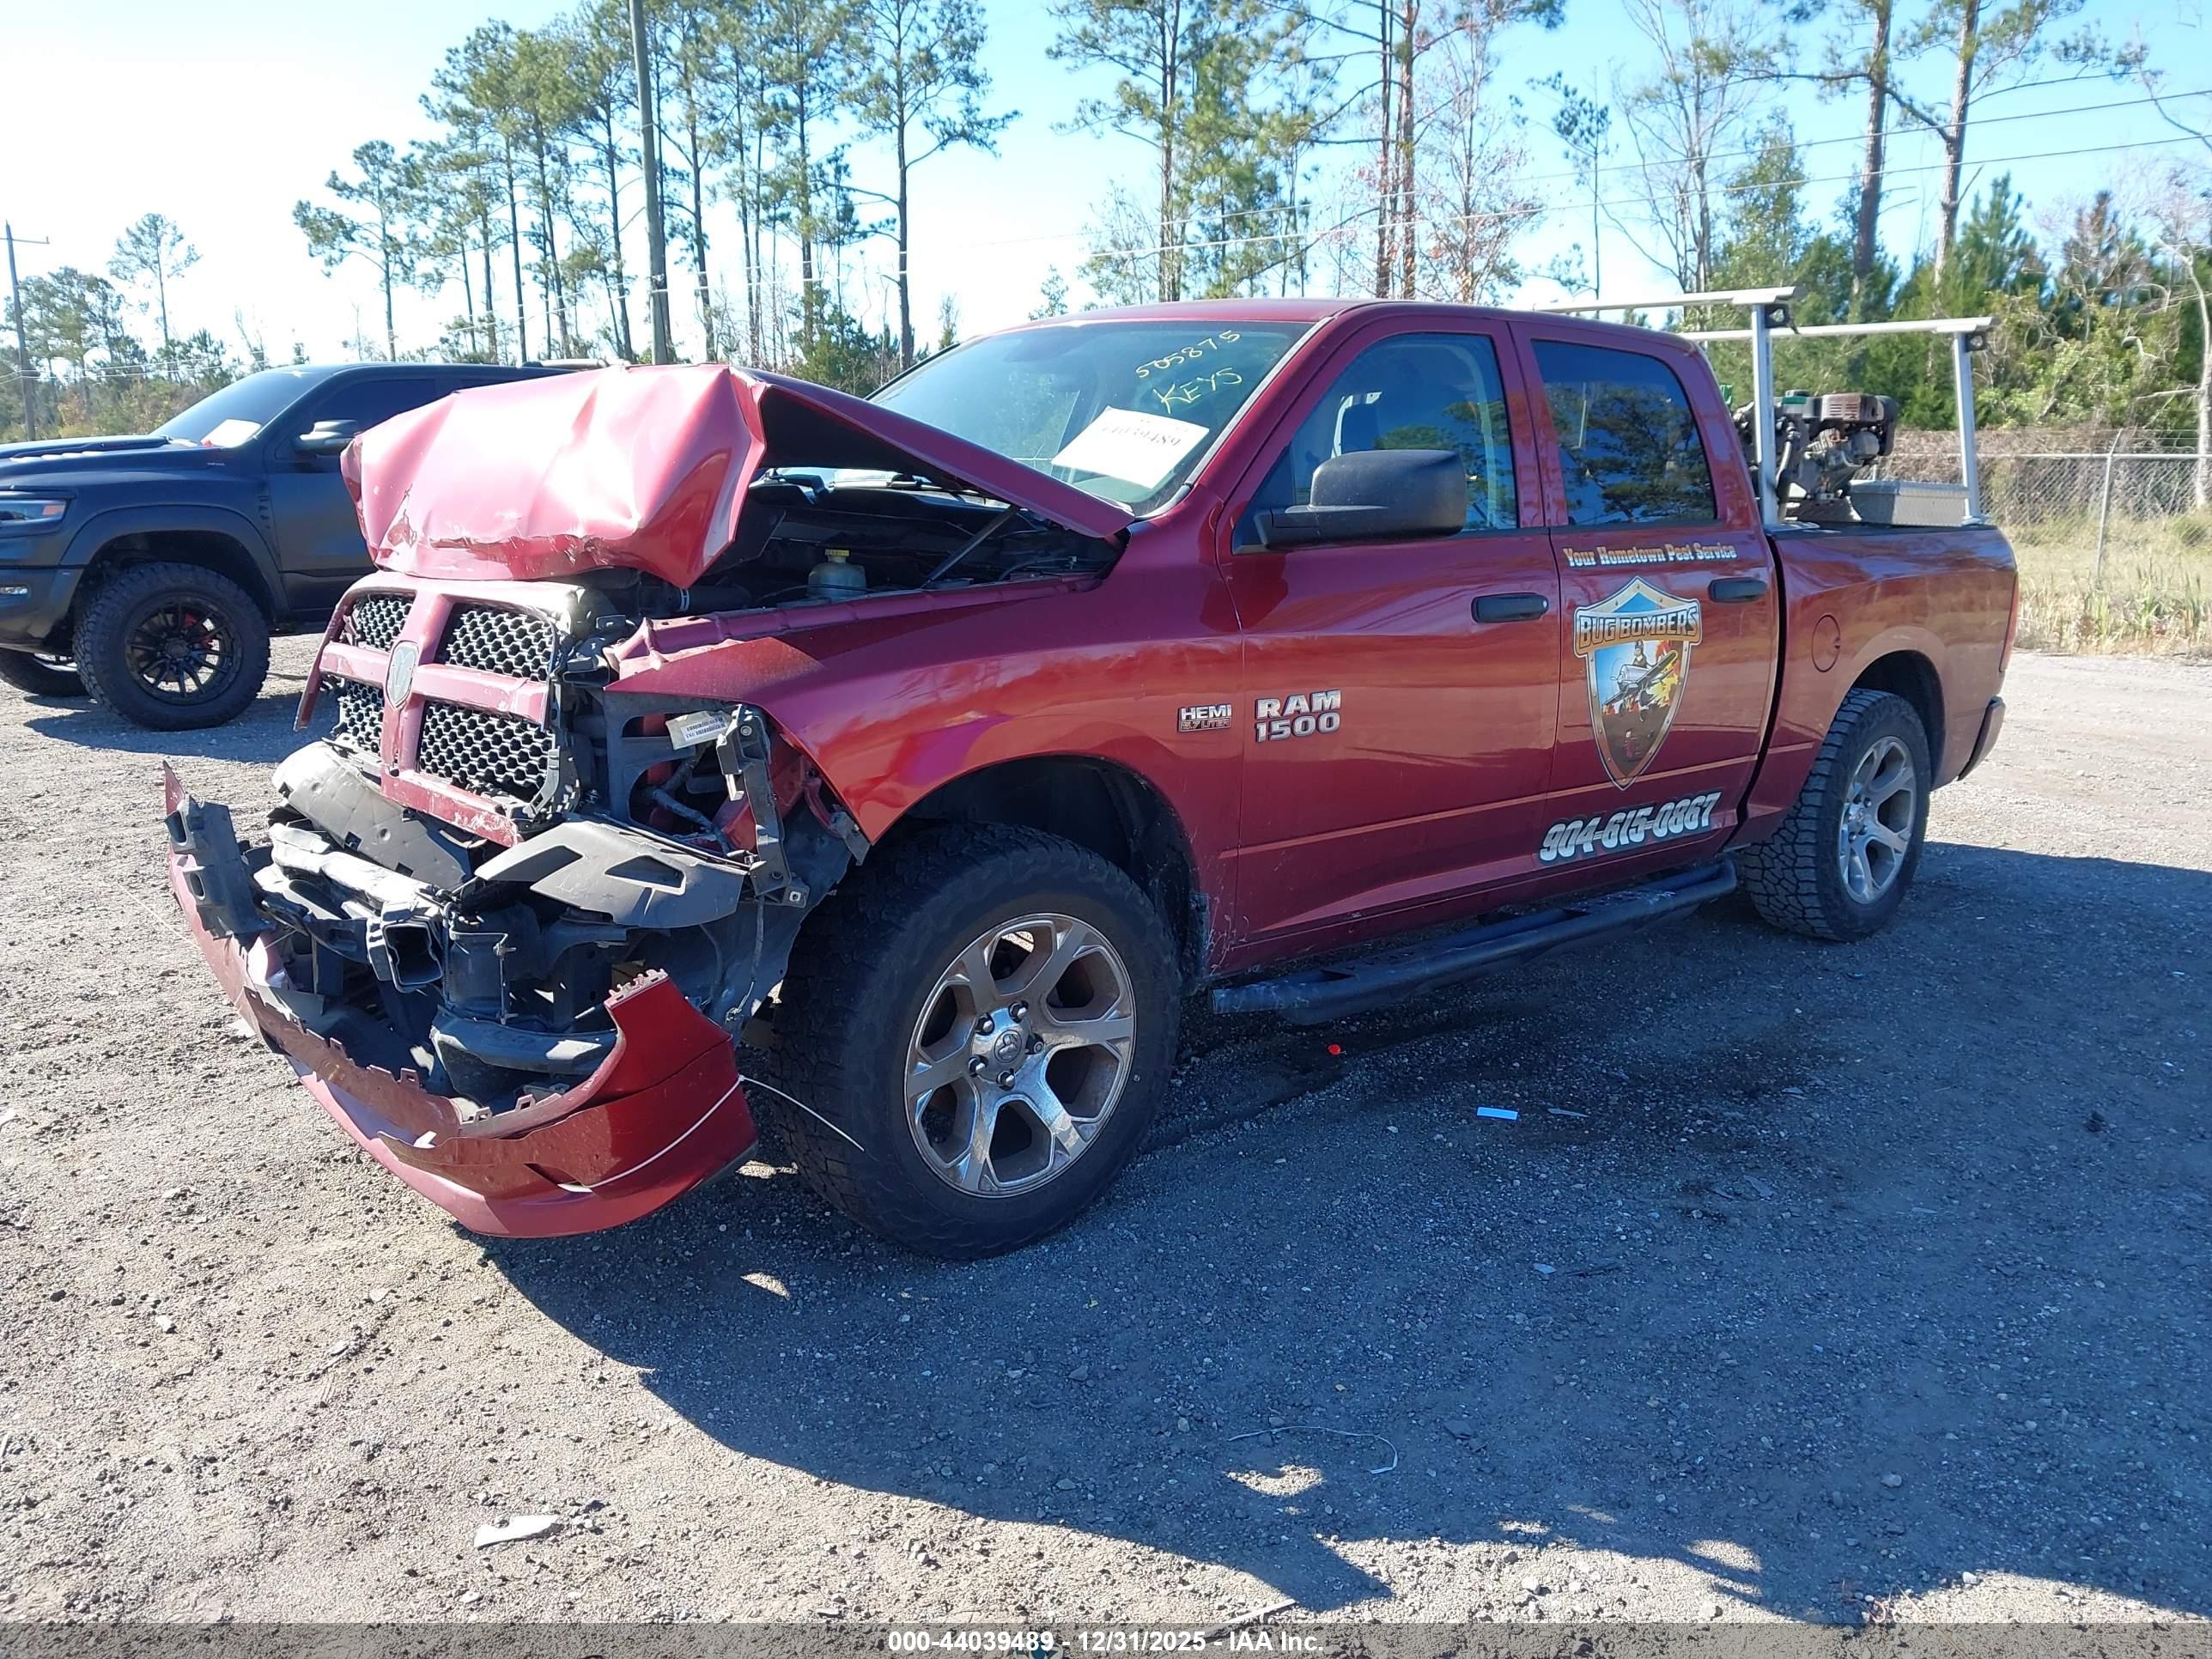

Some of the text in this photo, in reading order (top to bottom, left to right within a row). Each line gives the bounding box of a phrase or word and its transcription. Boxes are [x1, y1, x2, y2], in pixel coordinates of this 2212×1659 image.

[1135, 330, 1241, 378] 505875
[1152, 368, 1243, 414] KEYS
[1563, 542, 1738, 567] Your Hometown Pest Service
[1578, 605, 1699, 648] BUG BOMBERS
[1180, 704, 1232, 720] HEMI
[1255, 690, 1341, 720] RAM
[1255, 711, 1340, 743] 1500
[1540, 791, 1723, 861] 904-615-0867
